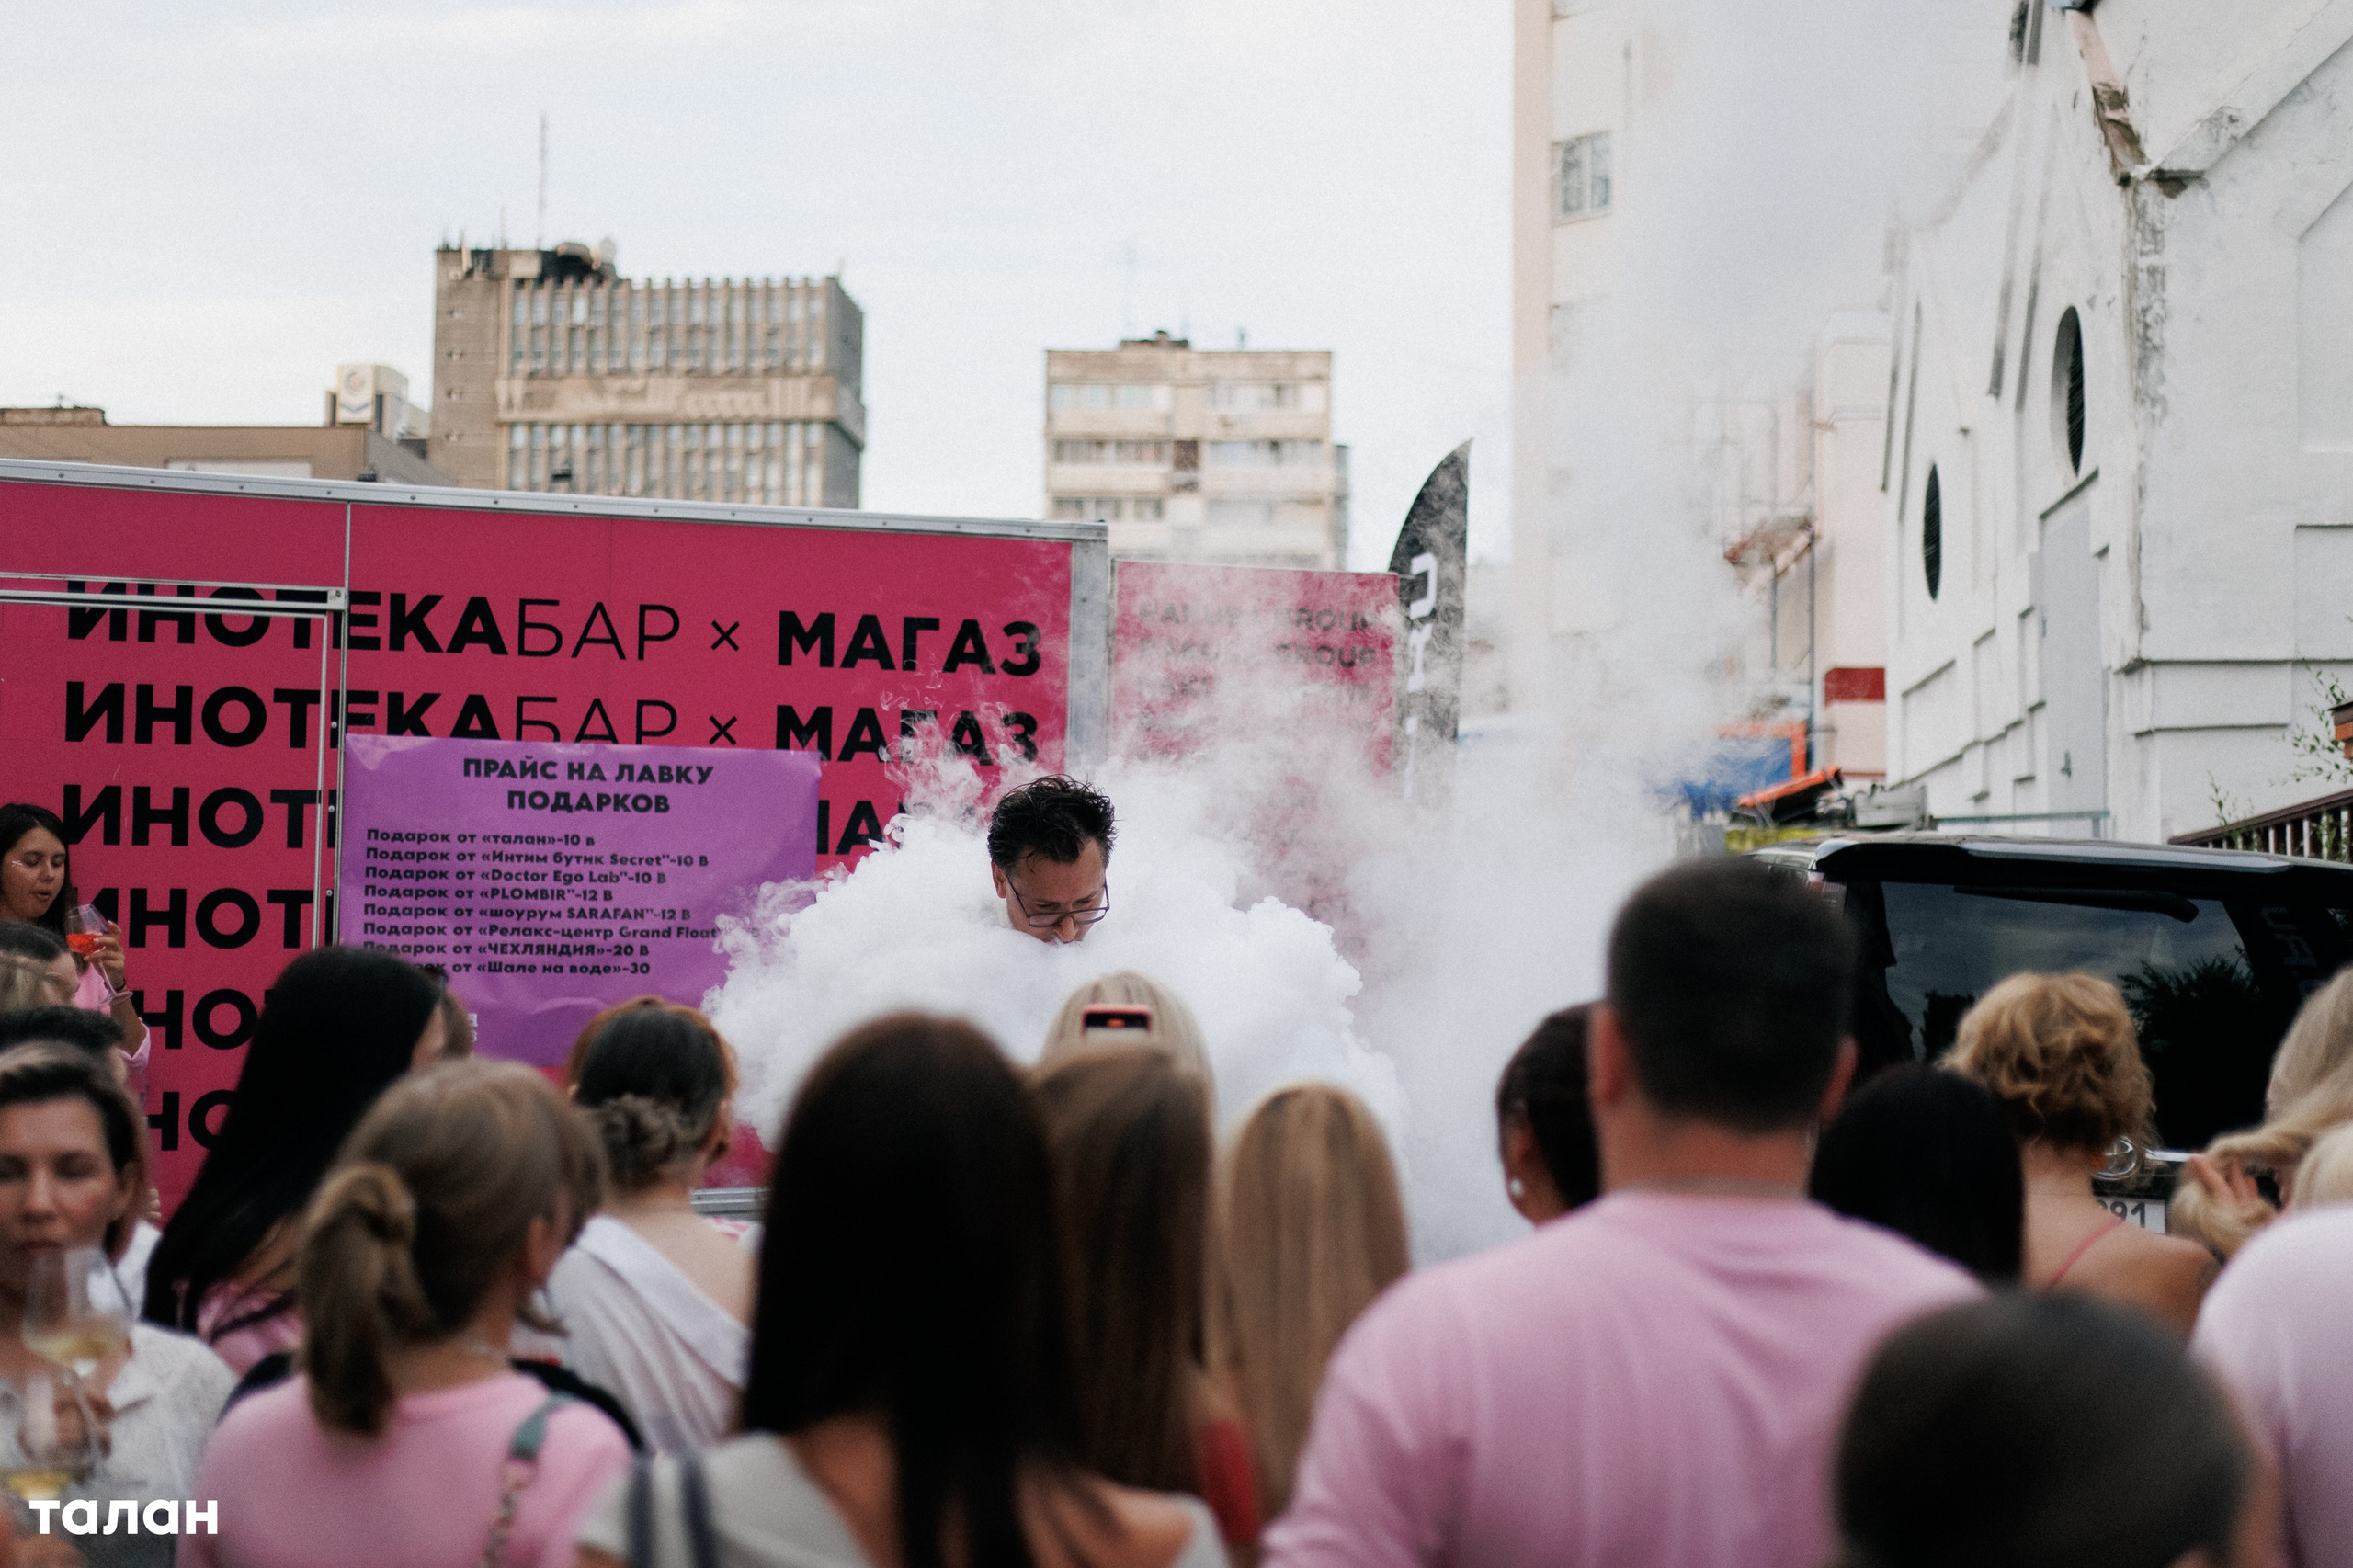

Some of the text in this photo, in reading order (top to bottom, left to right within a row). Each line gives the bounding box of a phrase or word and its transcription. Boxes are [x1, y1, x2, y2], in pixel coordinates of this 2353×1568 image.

[778, 610, 1042, 677] МАГАЗ
[463, 756, 714, 784] ПРАЙС НА ЛАВКУ
[507, 790, 670, 813] ПОДАРКОВ
[367, 829, 450, 844] Подарок
[457, 833, 477, 843] от
[366, 847, 450, 863] Подарок
[456, 851, 476, 861] от
[482, 850, 548, 863] «Интим
[553, 852, 604, 866] бутик
[365, 866, 449, 881] Подарок
[455, 870, 475, 881] от
[481, 869, 548, 882] «Doctor
[553, 871, 584, 886] Ego
[364, 885, 449, 900] Подарок
[454, 889, 474, 899] от
[363, 903, 448, 919] Подарок
[454, 908, 473, 917] от
[479, 907, 562, 920] «шоурум
[363, 922, 447, 937] Подарок
[453, 926, 473, 936] от
[478, 925, 614, 940] «Релакс-центр
[619, 926, 672, 939] Grand
[452, 945, 472, 954] от
[452, 963, 472, 972] от
[477, 961, 537, 973] «Шале
[542, 964, 563, 974] на
